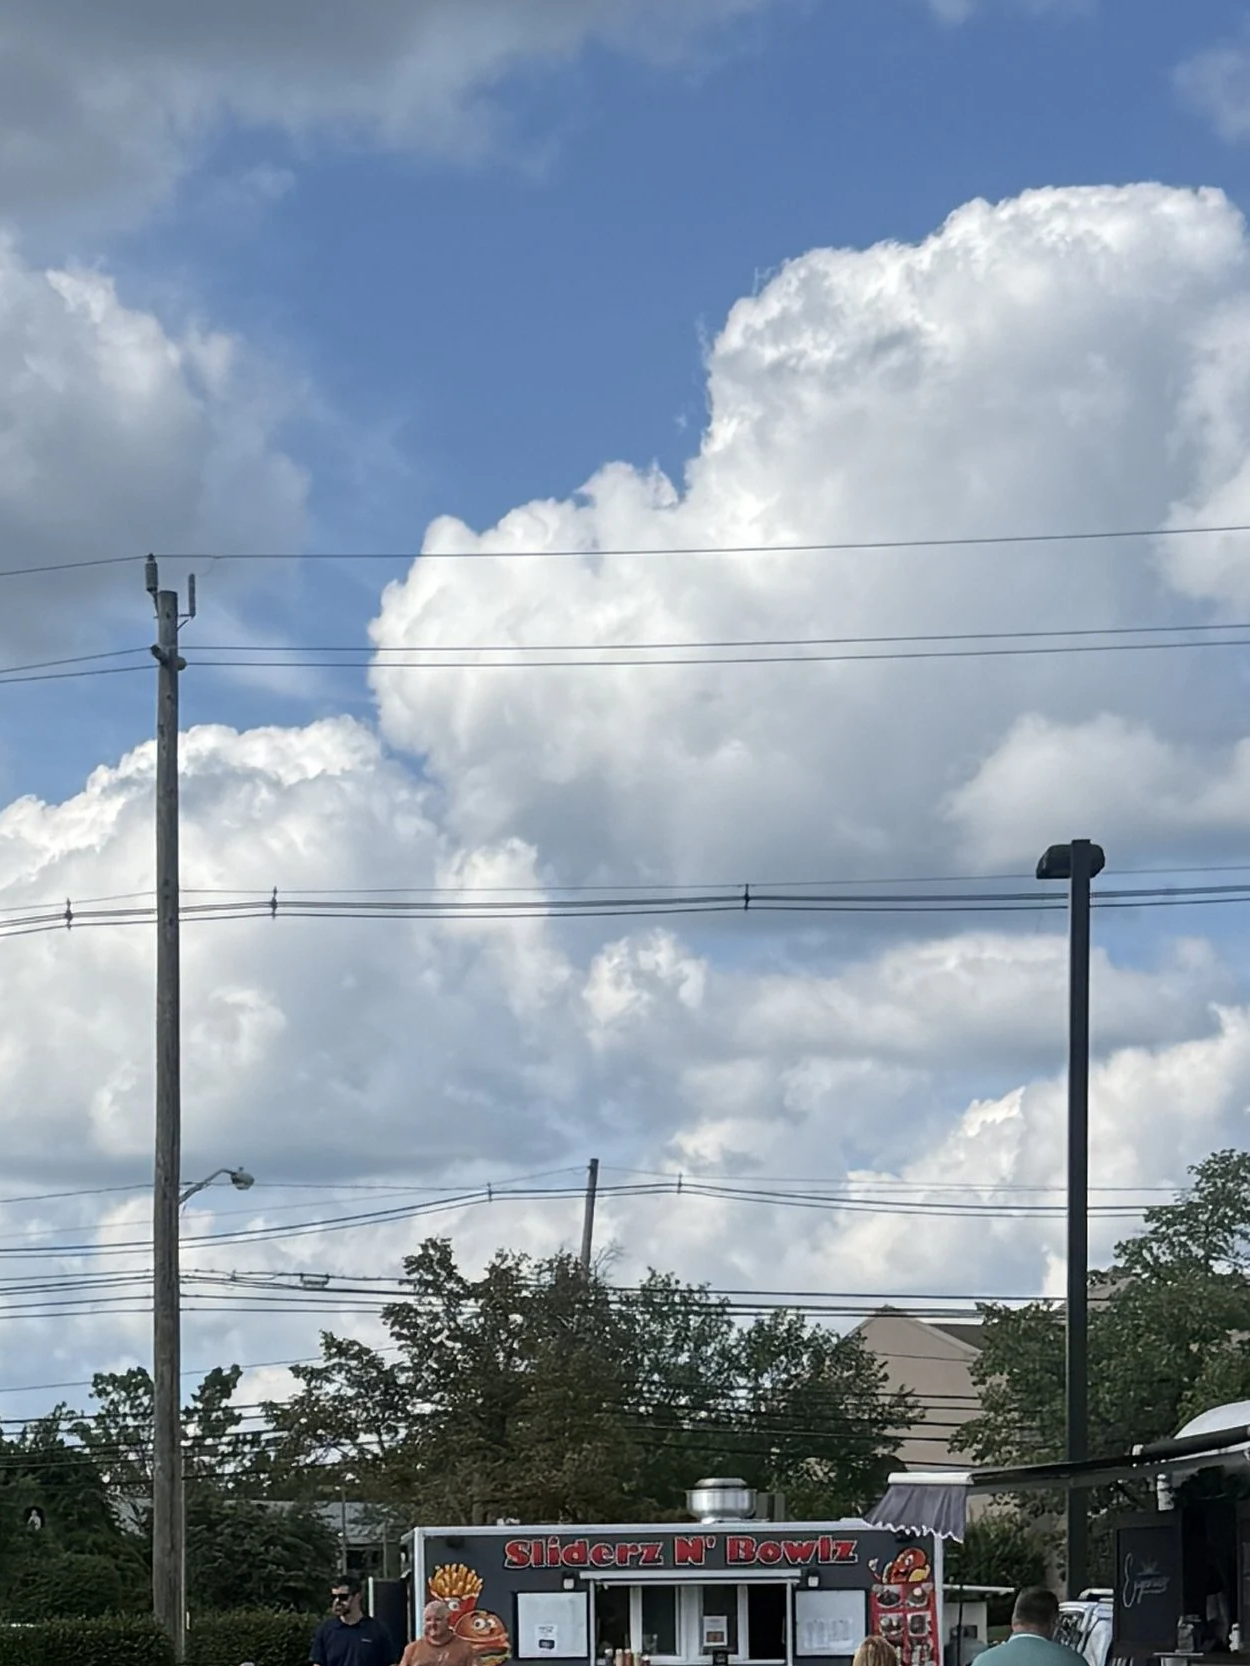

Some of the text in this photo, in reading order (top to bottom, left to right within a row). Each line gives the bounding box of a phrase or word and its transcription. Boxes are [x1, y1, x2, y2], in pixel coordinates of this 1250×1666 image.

[503, 1534, 859, 1569] Sliderz N' Bowlz
